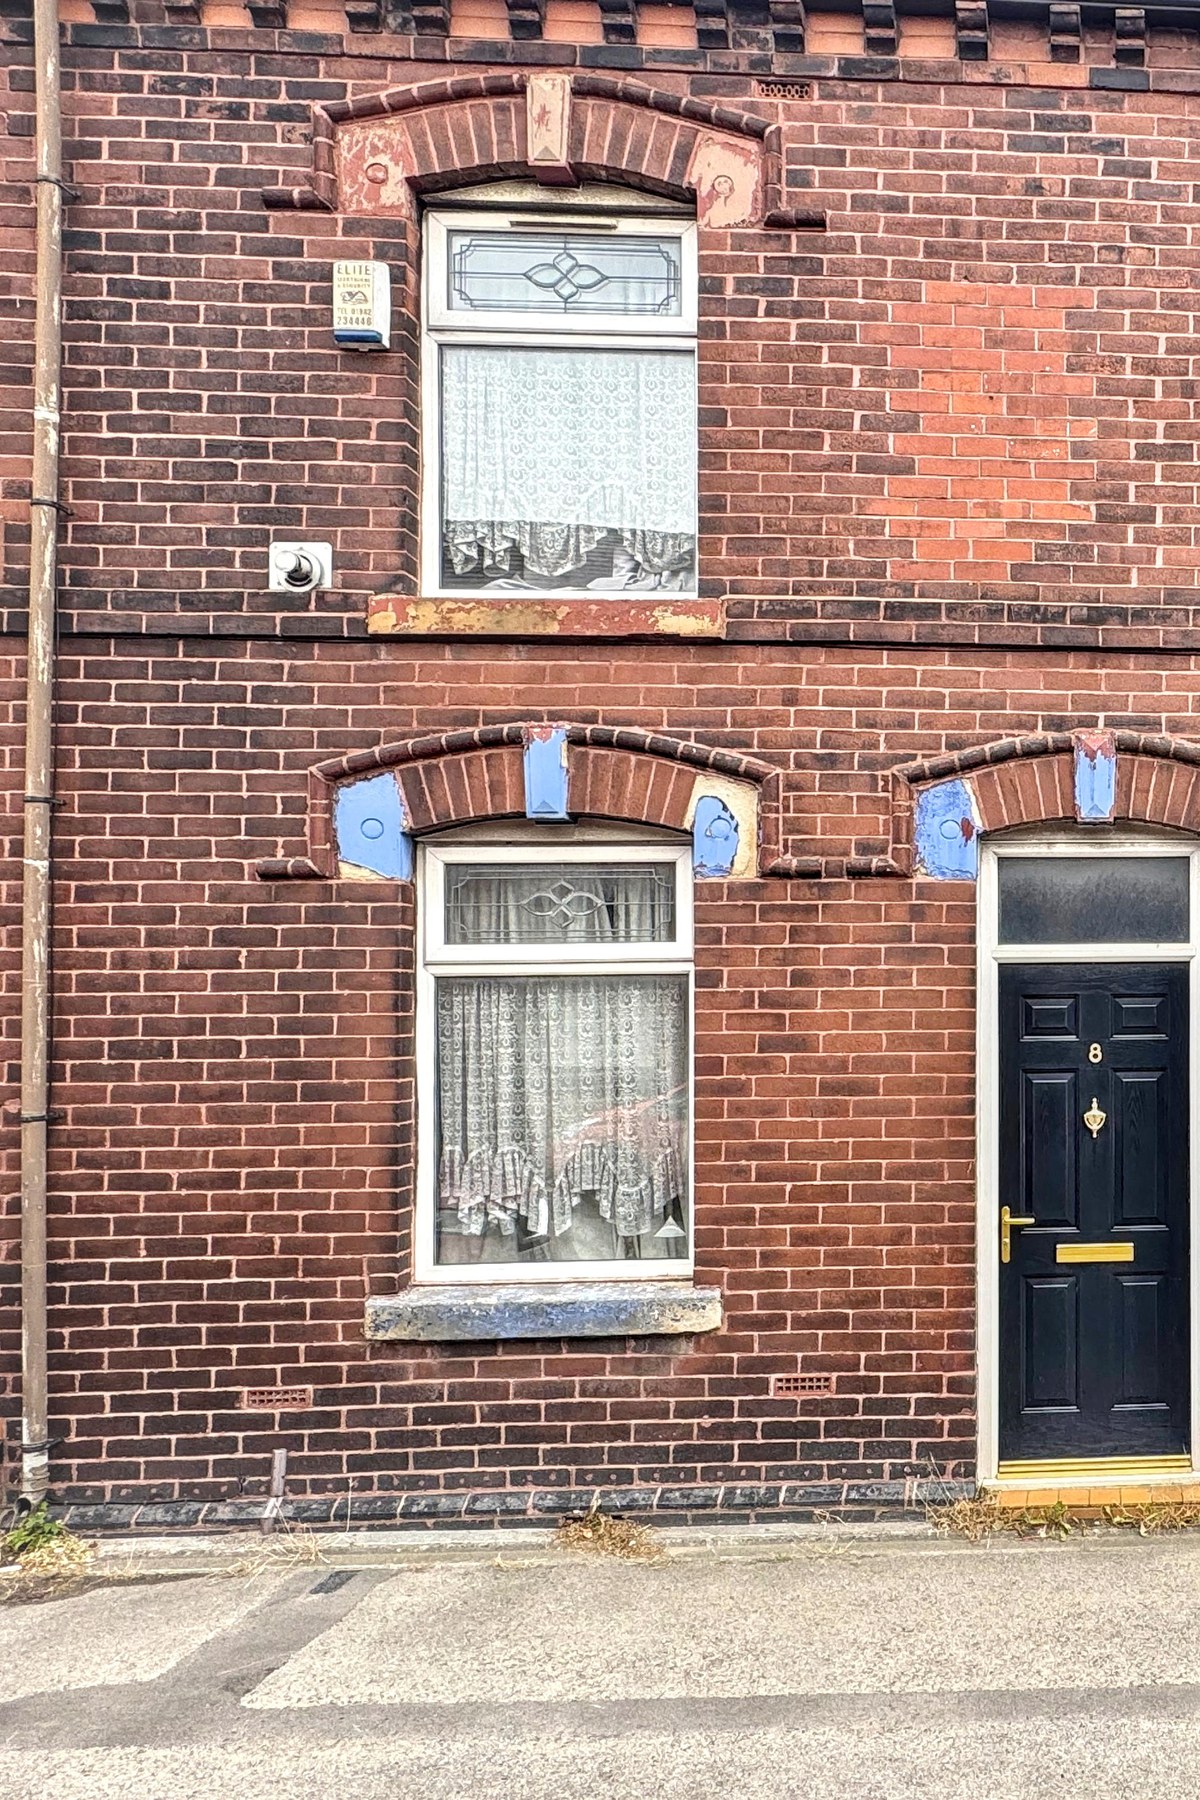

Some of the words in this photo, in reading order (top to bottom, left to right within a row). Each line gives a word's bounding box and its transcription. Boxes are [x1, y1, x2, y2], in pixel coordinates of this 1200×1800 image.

[337, 264, 372, 275] ELITE
[337, 307, 348, 315] TEL
[1089, 1042, 1103, 1063] 8
